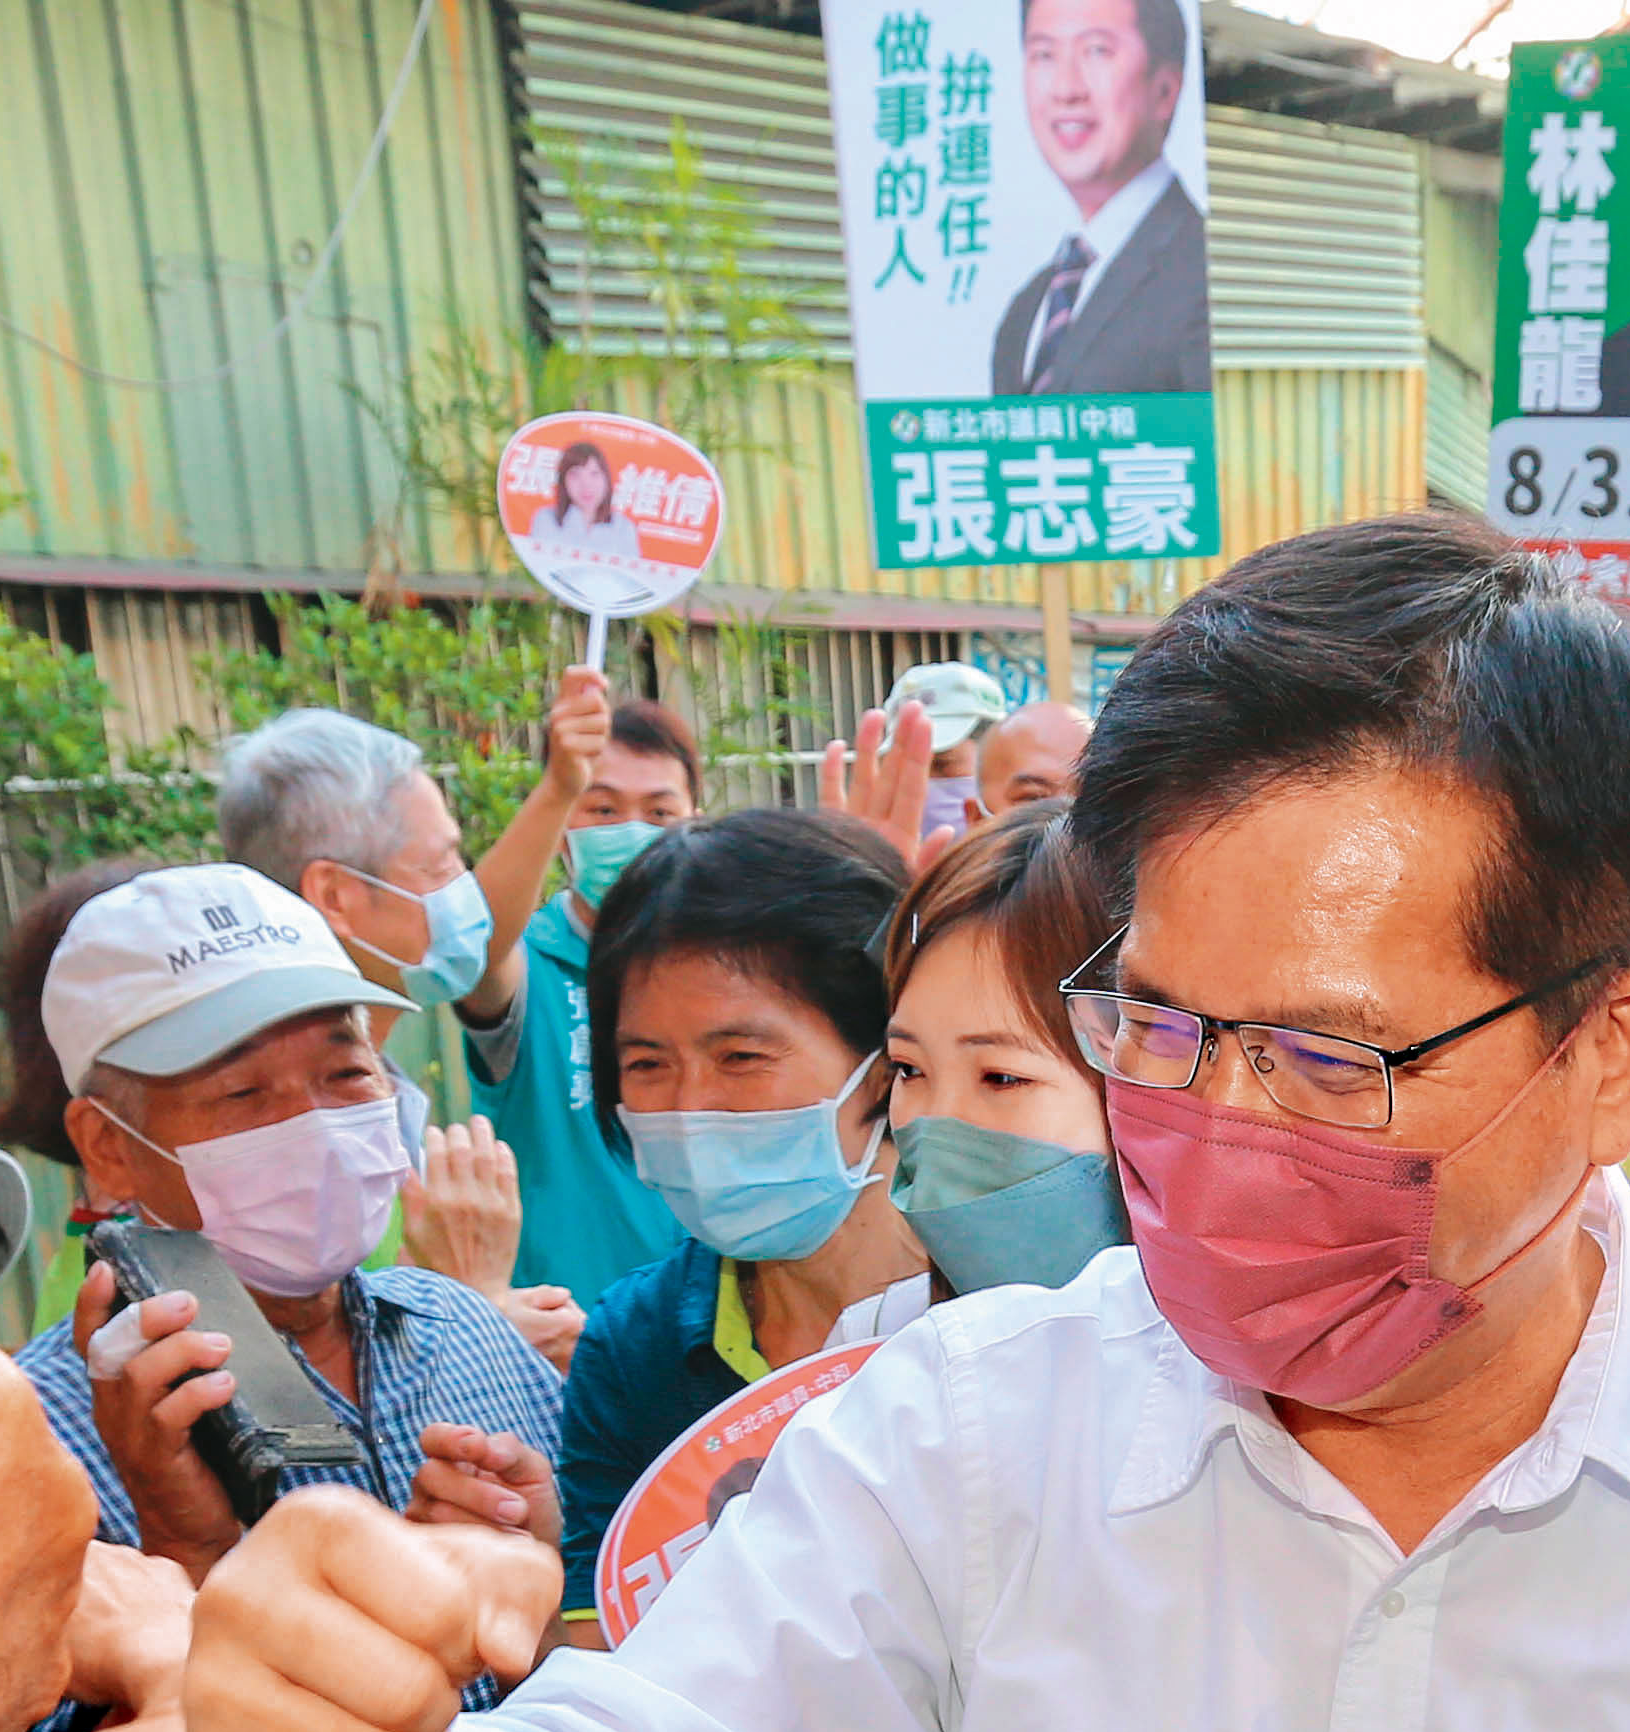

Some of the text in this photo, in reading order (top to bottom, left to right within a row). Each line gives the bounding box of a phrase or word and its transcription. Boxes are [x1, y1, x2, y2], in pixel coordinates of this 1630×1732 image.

[873, 12, 932, 290] 做事的人
[1517, 111, 1617, 416] 林佳龍
[891, 442, 1200, 561] 張志豪
[166, 922, 302, 975] MAESTRO
